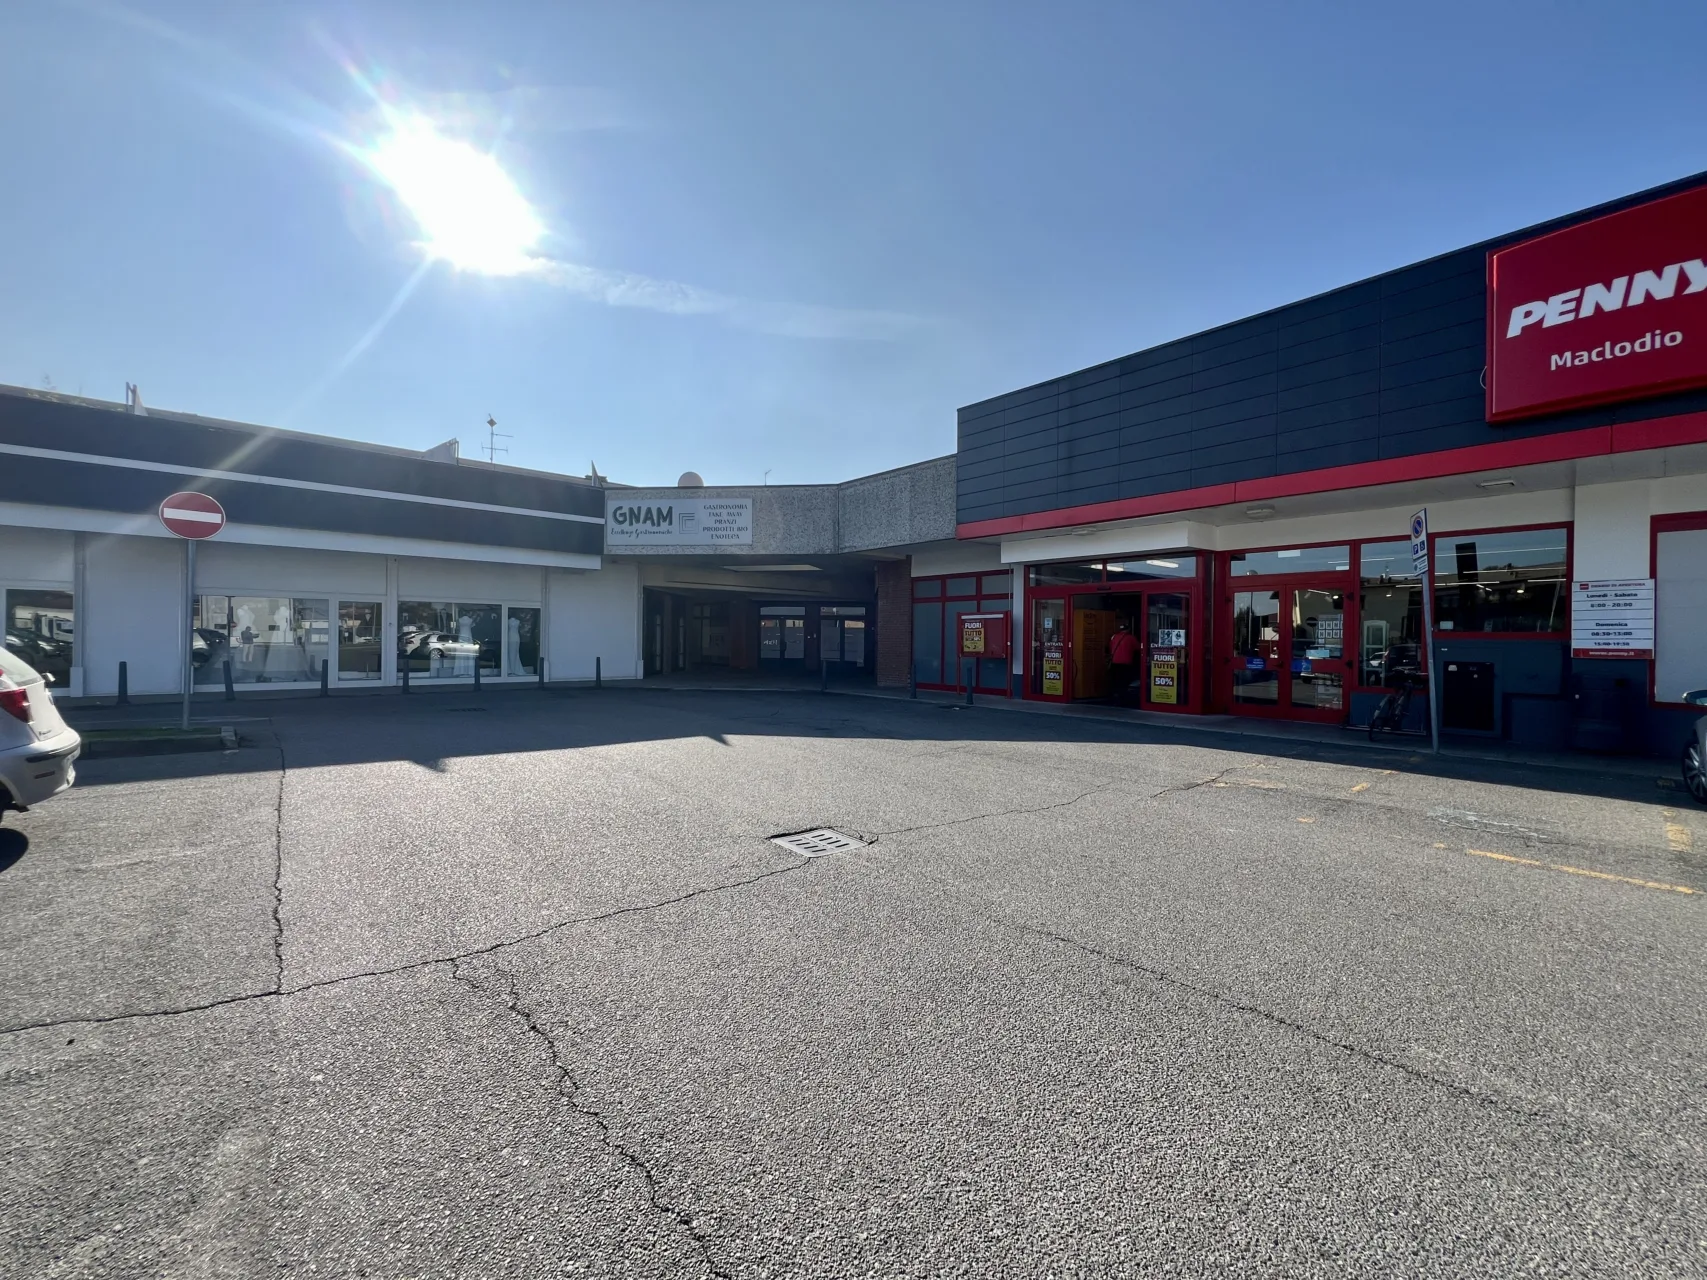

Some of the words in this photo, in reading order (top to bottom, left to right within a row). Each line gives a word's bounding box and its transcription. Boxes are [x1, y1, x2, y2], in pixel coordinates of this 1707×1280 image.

[1506, 258, 1707, 338] PENNY
[1550, 330, 1683, 371] Maclodio
[612, 506, 673, 527] GNAM
[1155, 677, 1173, 686] 50%
